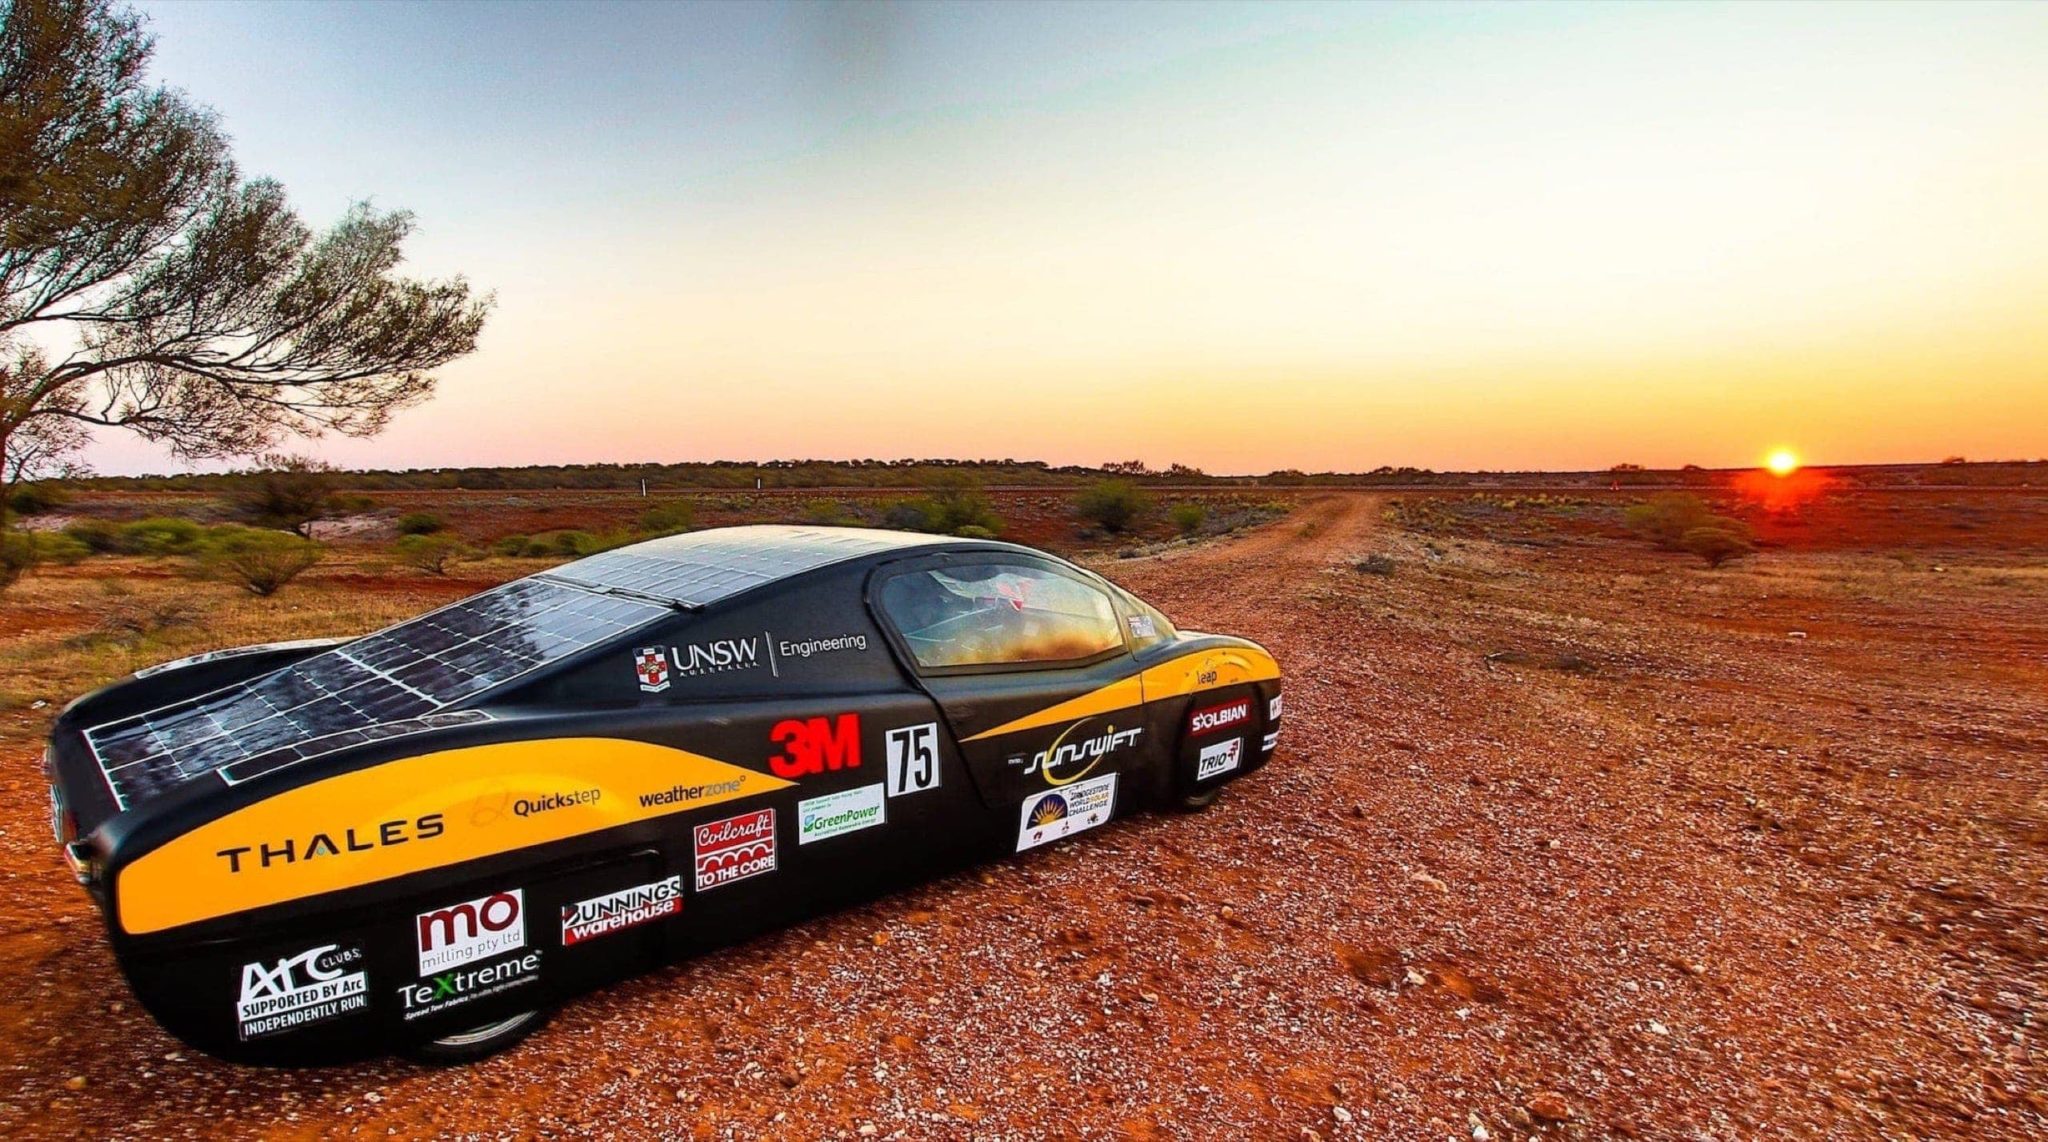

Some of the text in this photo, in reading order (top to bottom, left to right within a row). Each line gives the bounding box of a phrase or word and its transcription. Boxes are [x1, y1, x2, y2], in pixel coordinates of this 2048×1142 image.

[672, 637, 757, 671] UNSW
[780, 634, 867, 658] Engineering
[680, 661, 760, 678] AUSTRALIA
[768, 711, 862, 779] 3M
[892, 727, 933, 793] 75
[1201, 752, 1227, 772] TRIO
[514, 788, 601, 817] Quickstep
[815, 805, 880, 830] GreenPower
[217, 814, 444, 873] THALES
[697, 813, 771, 848] Coilcraft
[698, 855, 775, 887] TO THE CORE
[419, 891, 519, 952] mo
[572, 900, 675, 940] warehouse
[320, 948, 362, 969] CLUBS
[422, 930, 521, 970] milling pty ltd
[242, 979, 363, 1018] SUPPORTED BY Arc
[397, 953, 540, 1009] TeXtreme
[245, 994, 366, 1036] INDEPENDENTLY RUN
